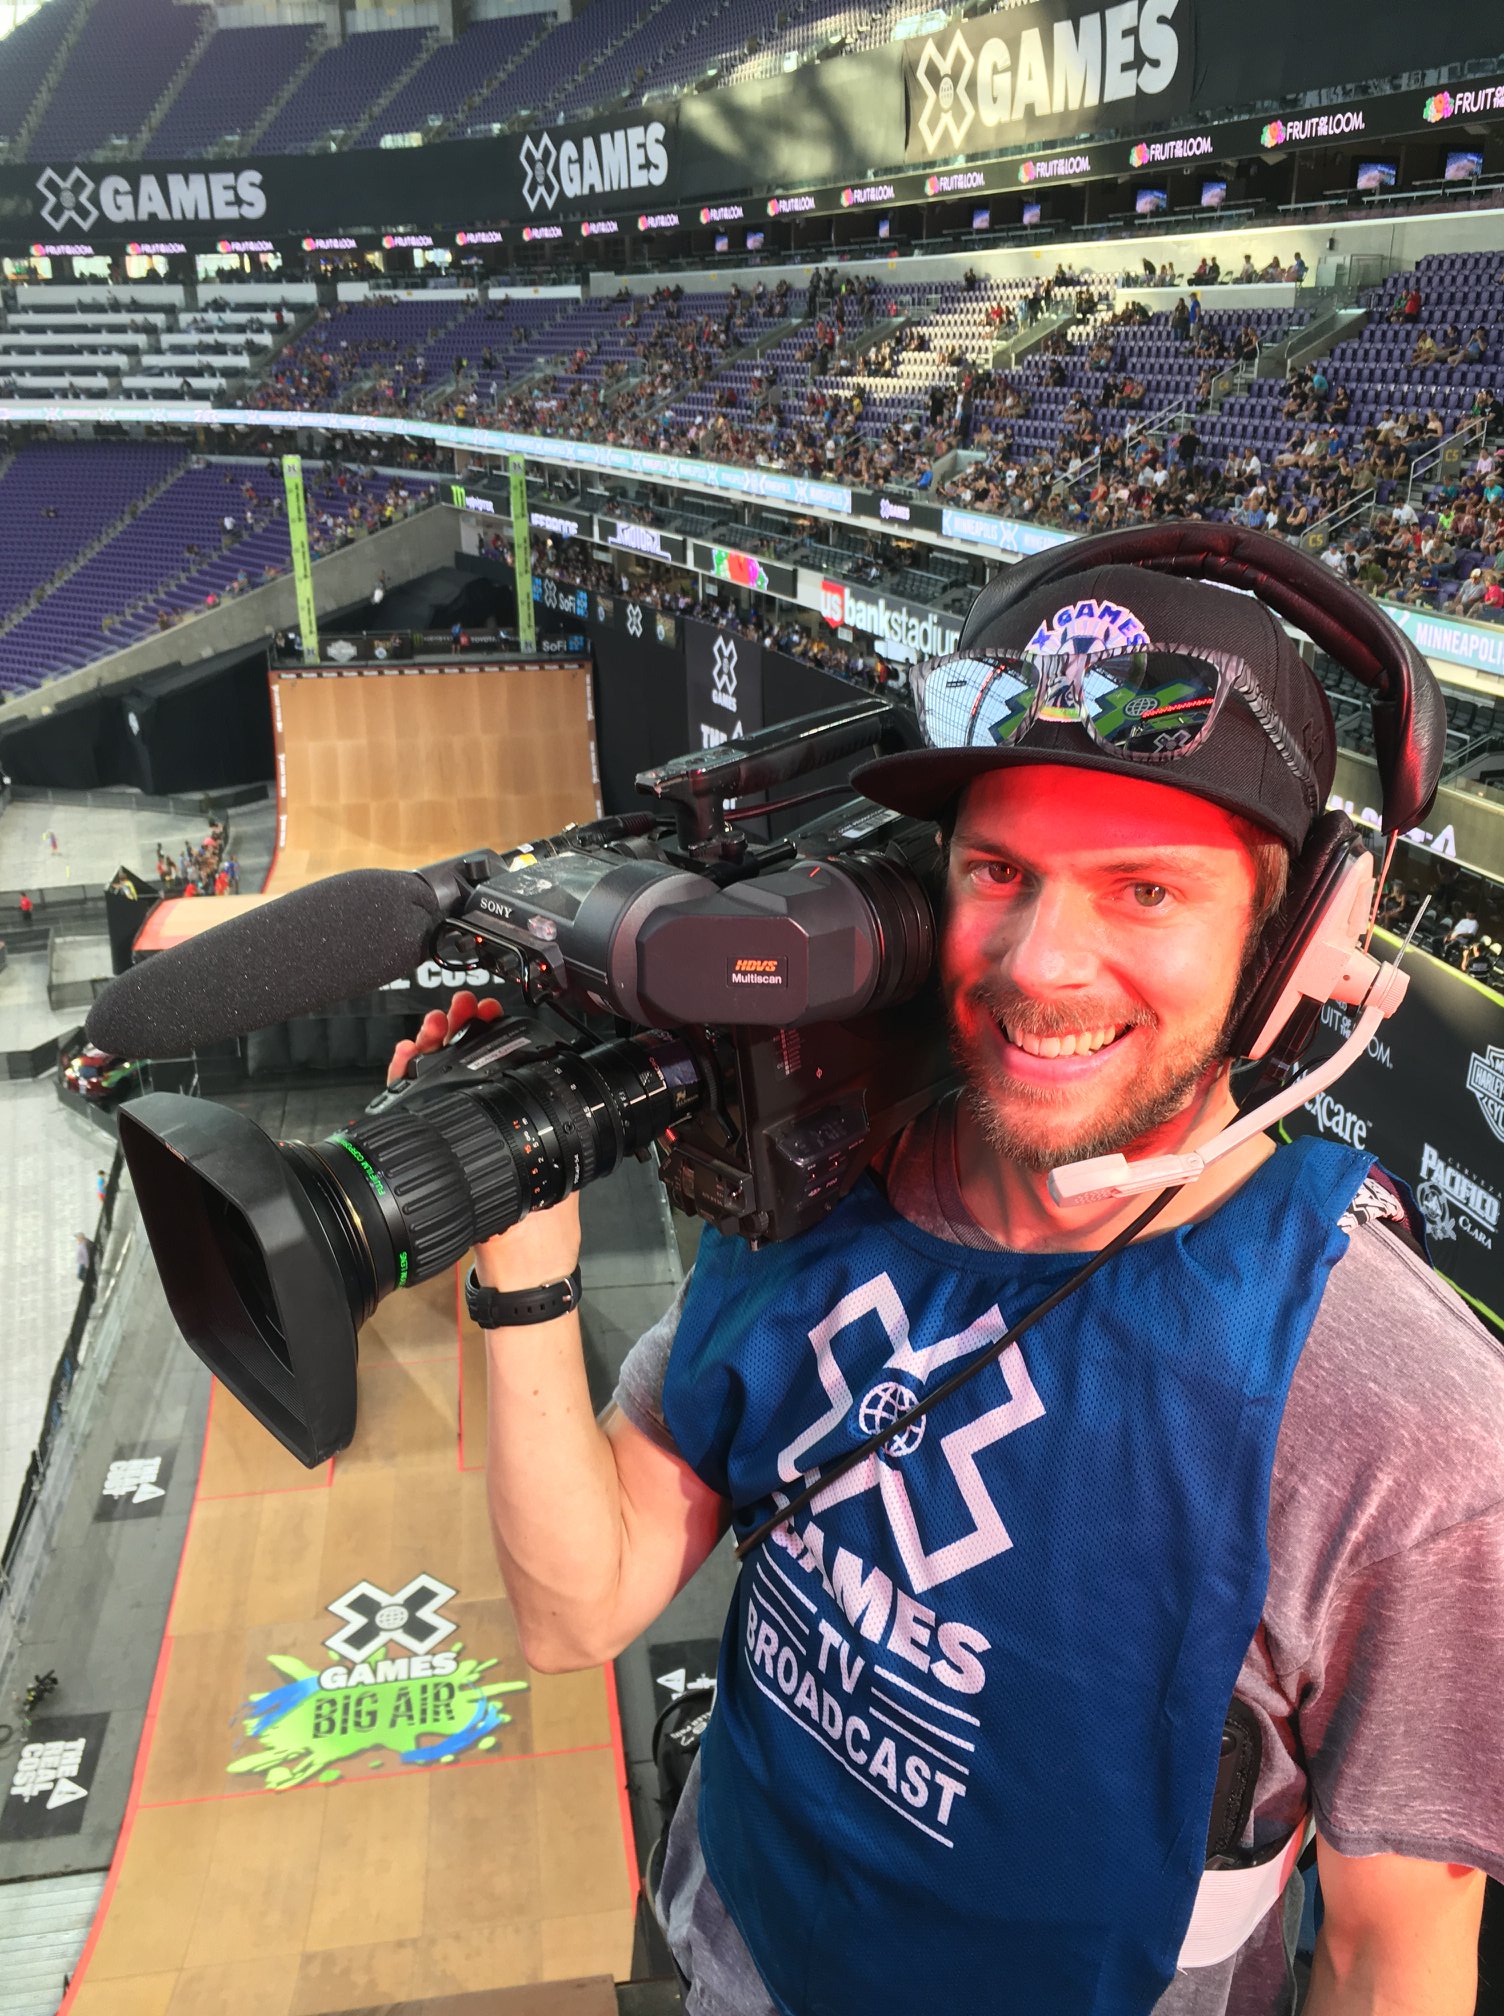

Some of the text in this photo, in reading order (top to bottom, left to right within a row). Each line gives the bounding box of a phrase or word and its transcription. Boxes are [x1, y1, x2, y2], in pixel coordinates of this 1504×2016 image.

[977, 0, 1179, 127] GAMES
[1455, 87, 1495, 115] FRUIT
[1286, 117, 1320, 141] FRUIT
[559, 121, 668, 199] GAMES
[1150, 141, 1176, 162] FRUIT
[100, 169, 267, 223] GAMES
[1057, 603, 1146, 646] GAMES
[1415, 622, 1504, 665] MINNEAPOLI
[480, 897, 513, 919] SONY
[416, 958, 506, 988] COS
[732, 973, 782, 984] Multiscan
[735, 959, 778, 972] HDVS
[1320, 1003, 1342, 1031] UIT
[1448, 1157, 1502, 1199] CERVEZA
[1459, 1216, 1492, 1250] CLARA
[319, 1651, 458, 1690] GAMES
[818, 1618, 866, 1695] TV
[312, 1682, 455, 1739] BIG AIR
[747, 1597, 967, 1826] BROADCAST
